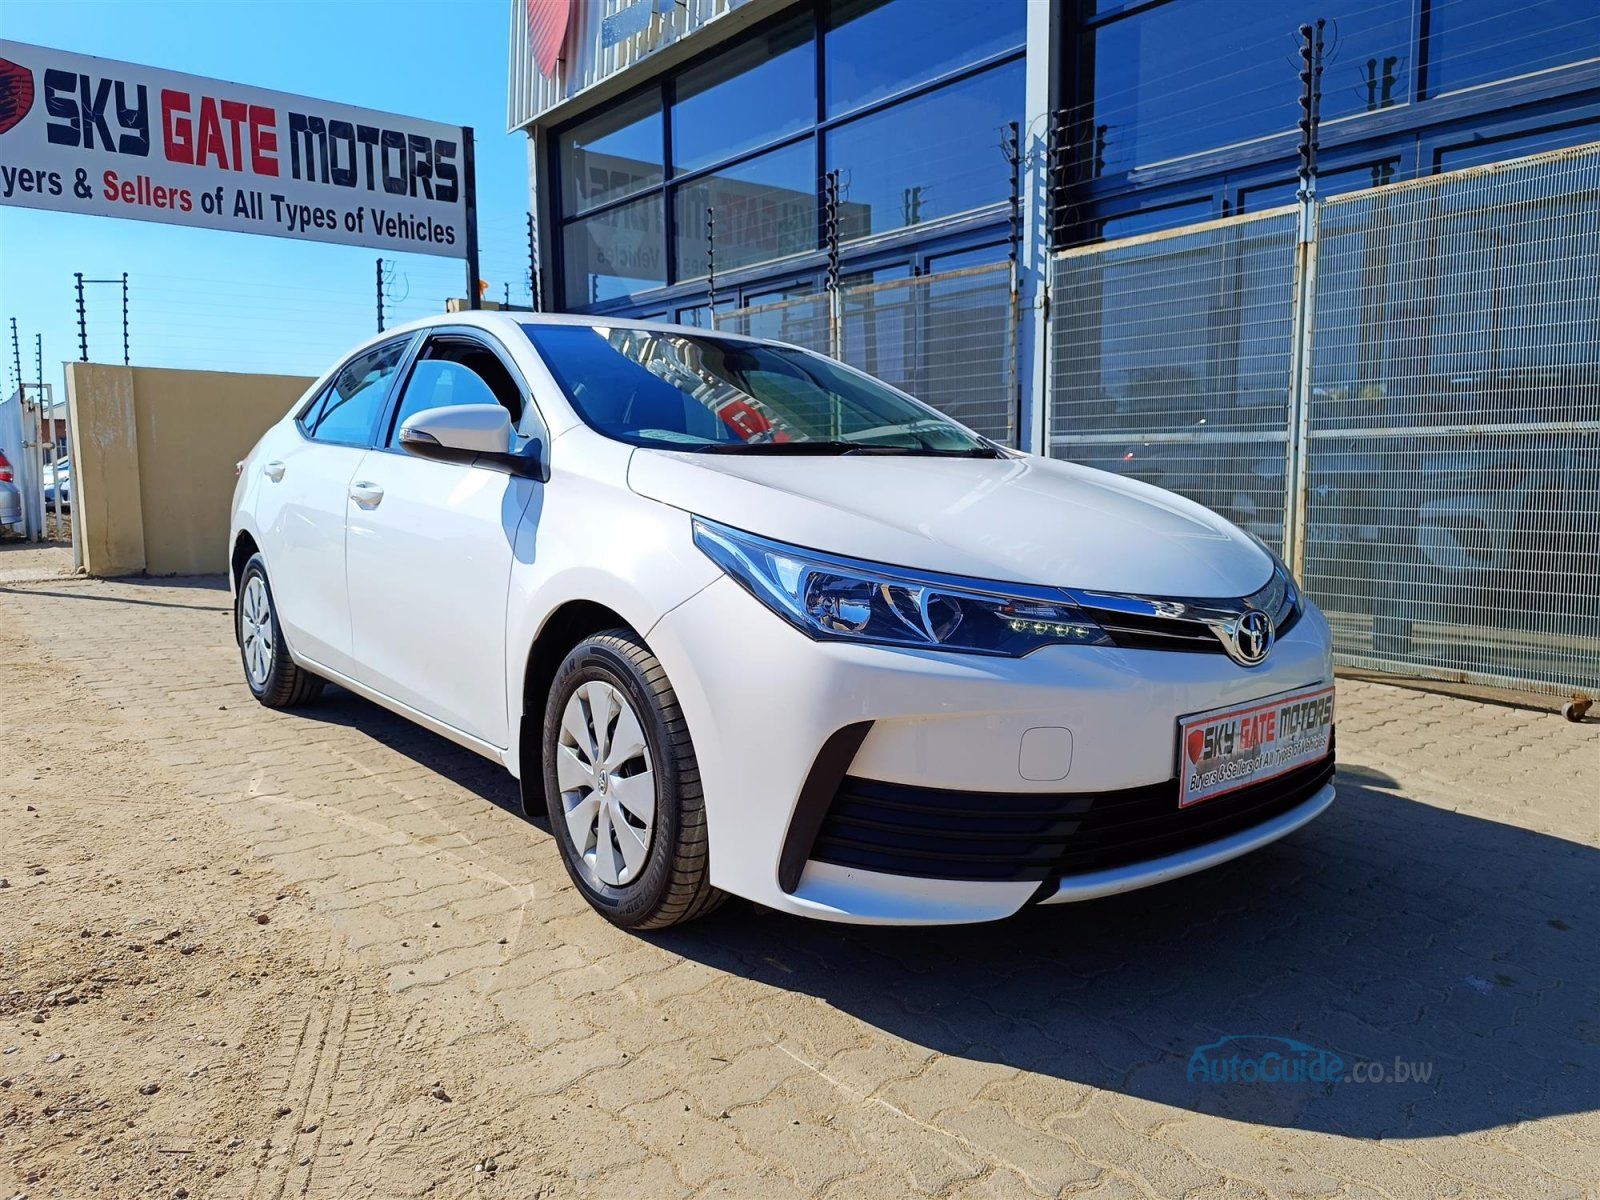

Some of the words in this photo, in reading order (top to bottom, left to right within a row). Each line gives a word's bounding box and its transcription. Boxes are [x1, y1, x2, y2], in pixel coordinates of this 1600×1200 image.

[44, 68, 150, 157] SKY
[161, 88, 279, 177] GATE
[288, 111, 458, 203] MOTORS
[0, 165, 63, 198] yers
[73, 167, 93, 199] &
[103, 170, 193, 212] Sellers
[201, 186, 224, 215] of
[233, 189, 264, 220] All
[270, 194, 337, 233] Types
[344, 206, 365, 233] of
[371, 208, 456, 245] Vehicles
[1203, 721, 1235, 760] SKY
[1240, 711, 1276, 749] GATE
[1280, 696, 1332, 738] MOTORS
[1190, 769, 1217, 791] Buyers
[1219, 764, 1228, 782] &
[1226, 759, 1254, 777] Sellers
